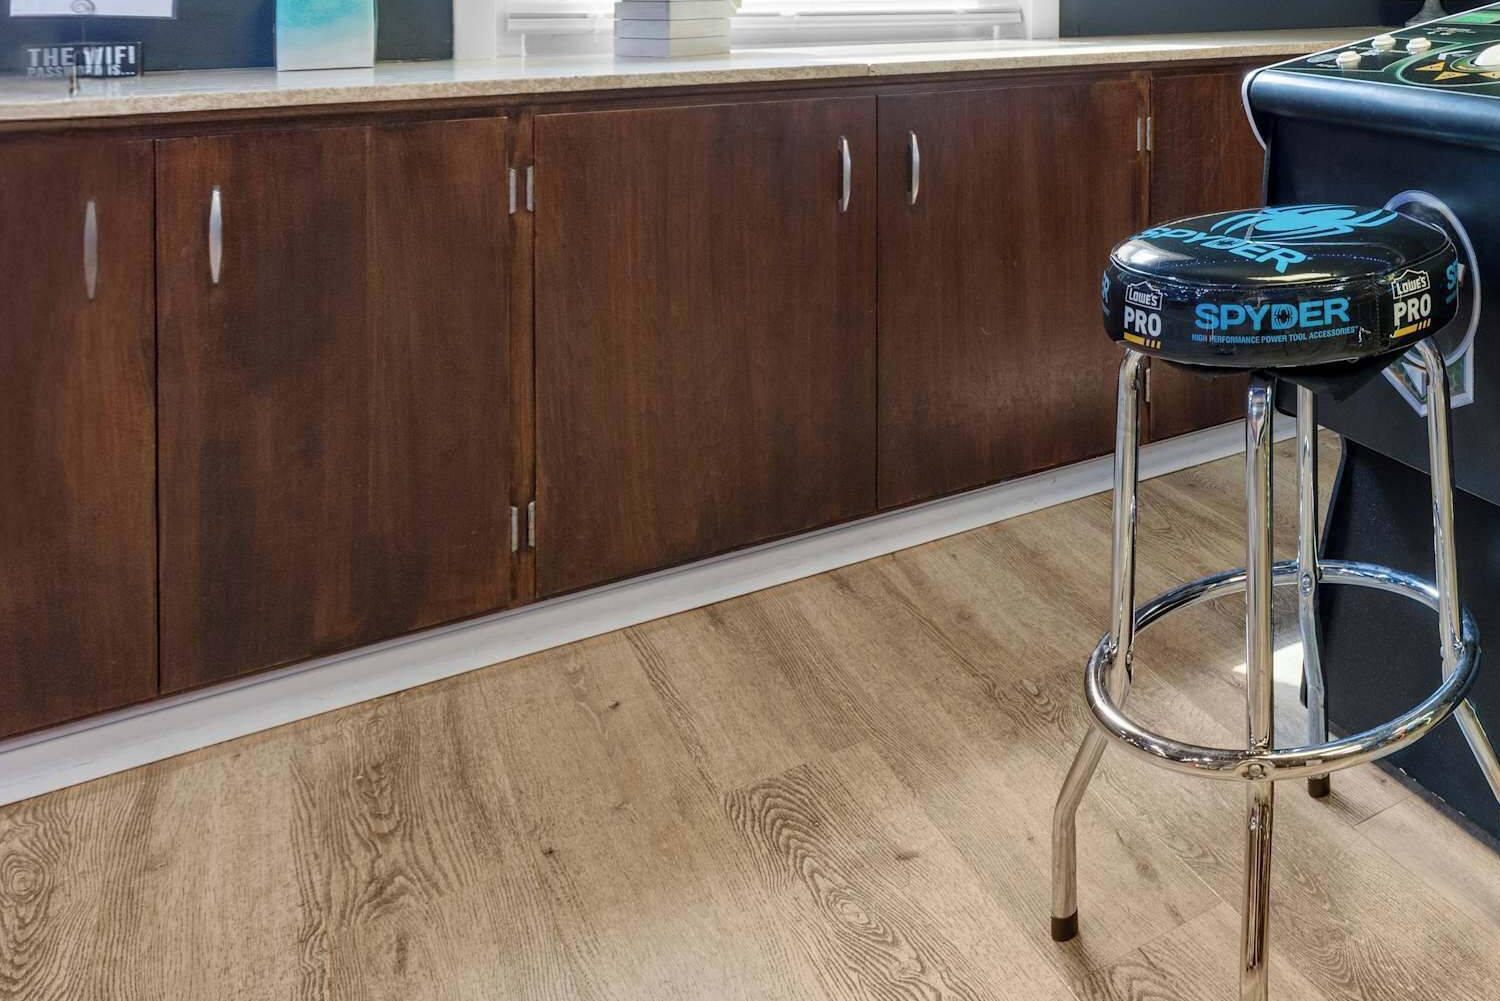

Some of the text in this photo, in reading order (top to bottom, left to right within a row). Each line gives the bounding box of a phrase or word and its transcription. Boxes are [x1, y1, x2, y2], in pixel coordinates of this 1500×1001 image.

[27, 45, 136, 67] THE WIFI
[1130, 227, 1308, 274] SPYDER
[1129, 287, 1158, 307] LOWE'S
[1397, 276, 1428, 295] LOWE'S
[1124, 306, 1162, 337] PRO
[1194, 297, 1350, 331] SPYDER
[1393, 293, 1432, 327] PRO
[1192, 326, 1356, 344] HIGH PERFORMANCE POWER TOOL ACCESSORIES
